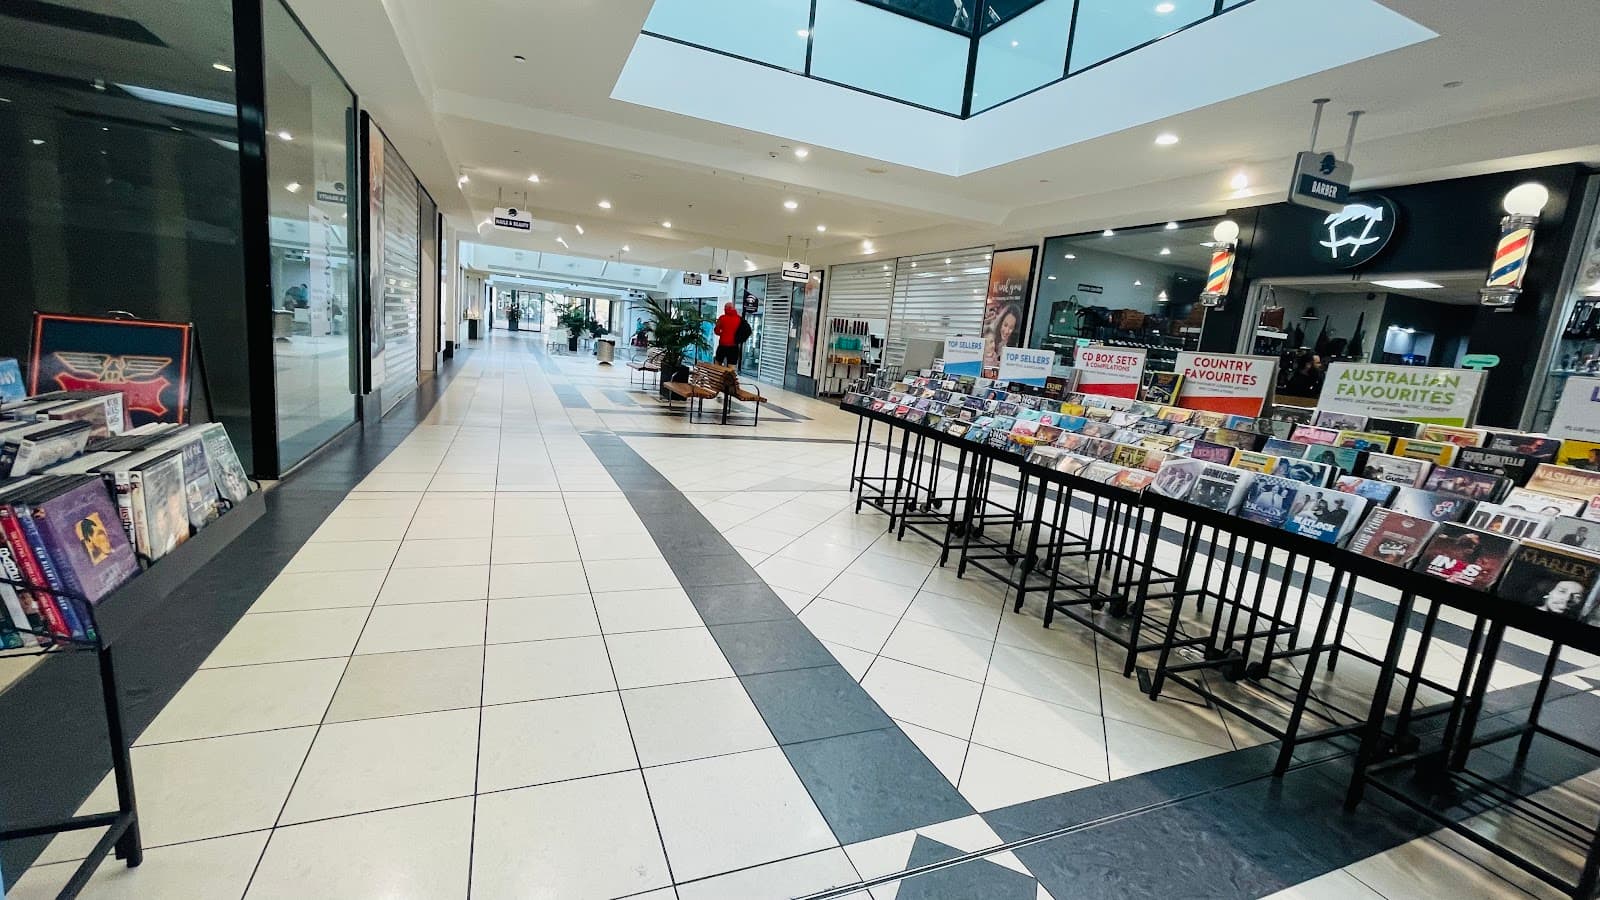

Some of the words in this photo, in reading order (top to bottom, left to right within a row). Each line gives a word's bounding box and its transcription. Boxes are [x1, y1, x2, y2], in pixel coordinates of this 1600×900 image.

[1311, 181, 1338, 199] BARBER
[948, 340, 958, 349] TOP
[959, 341, 982, 350] SELLERS
[1006, 352, 1018, 361] TOP
[1020, 354, 1050, 365] SELLERS
[1082, 352, 1094, 361] CD
[1096, 353, 1114, 364] BOX
[1116, 355, 1138, 366] SETS
[1090, 362, 1130, 372] COMPILATIONS
[1194, 357, 1253, 372] COUNTRY
[1184, 368, 1257, 386] FAVOURITES
[1339, 369, 1461, 389] AUSTRALIAN
[1336, 383, 1456, 405] FAVOURITES
[1292, 515, 1336, 532] MATLOCK
[1297, 524, 1322, 536] Police
[1430, 554, 1482, 577] INXS
[1521, 551, 1593, 578] MARLEY
